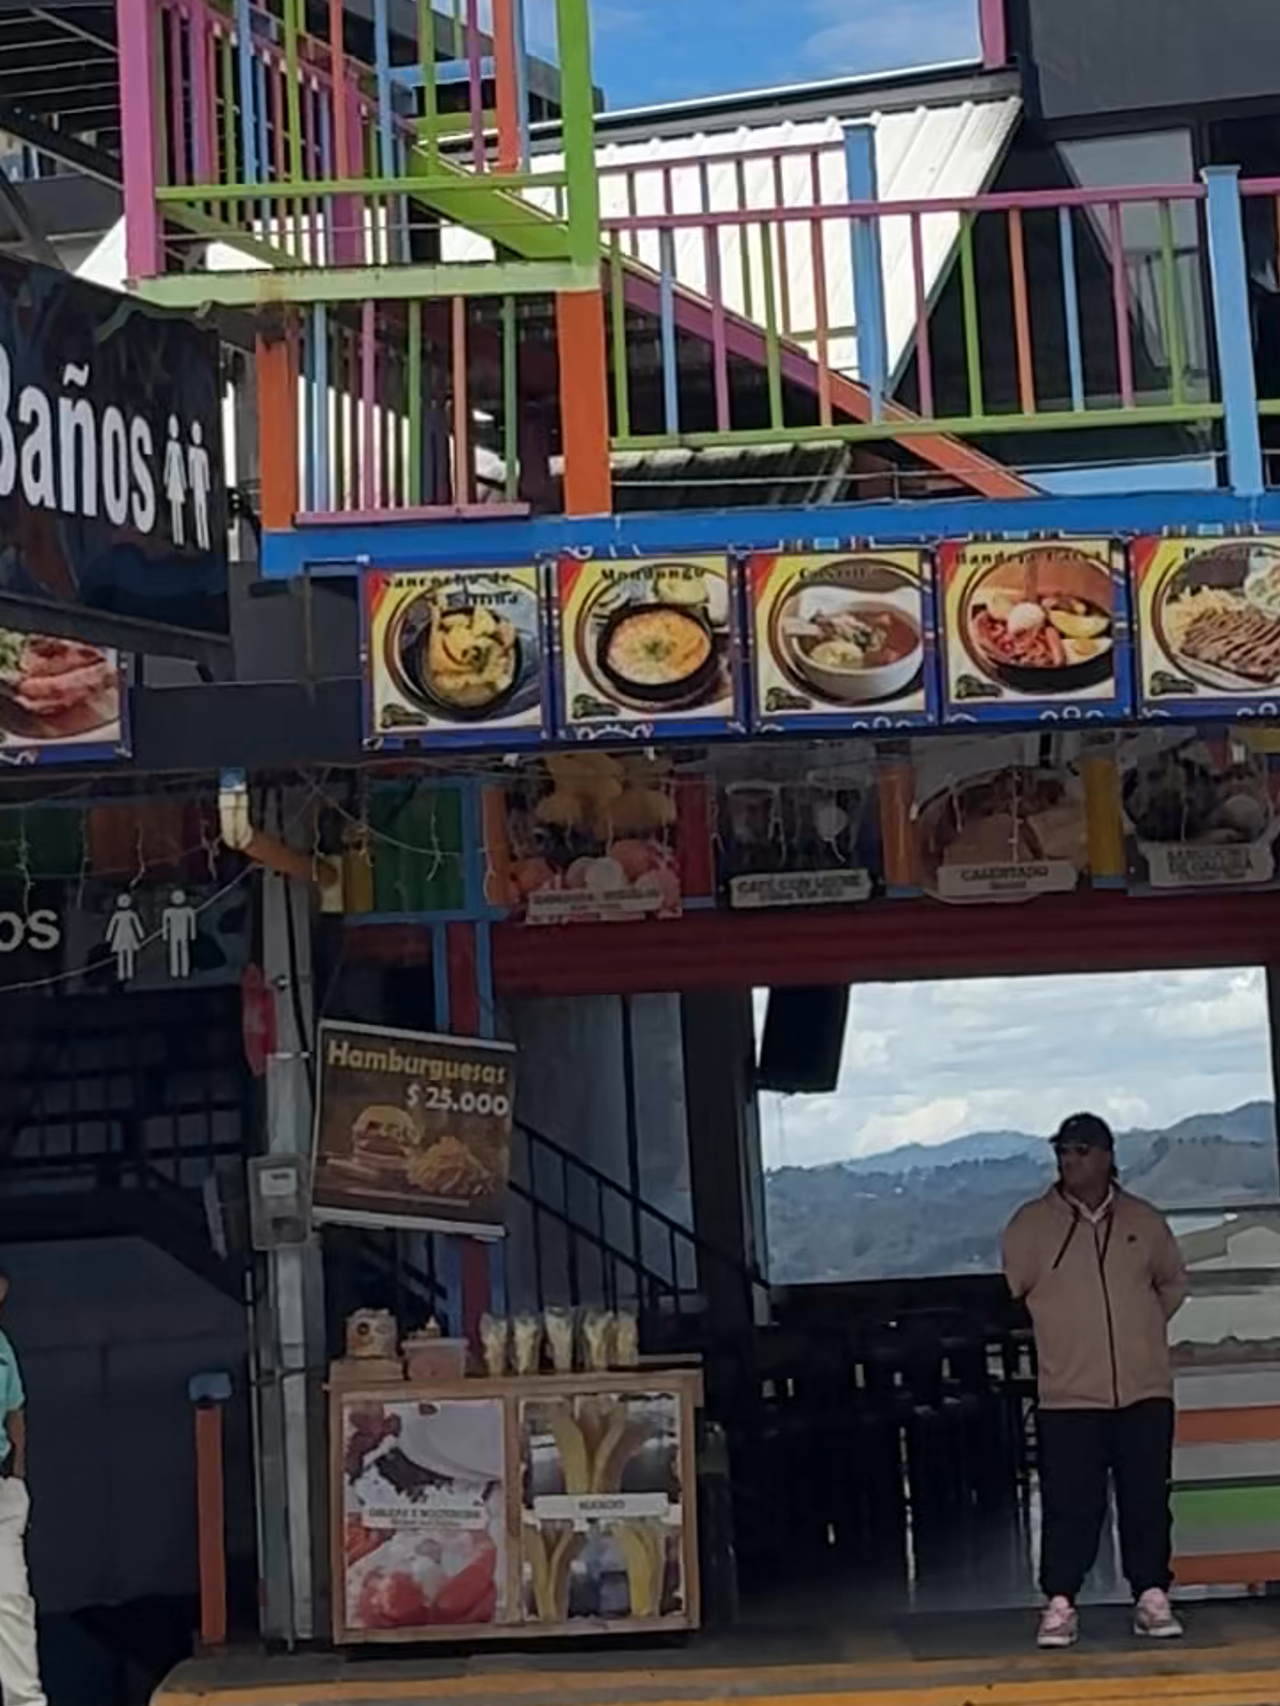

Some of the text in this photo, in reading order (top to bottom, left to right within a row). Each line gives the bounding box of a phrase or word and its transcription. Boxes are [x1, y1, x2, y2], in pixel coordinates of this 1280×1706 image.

[326, 1039, 507, 1084] Hamburguesas
[406, 1082, 509, 1117] $ 25.000
